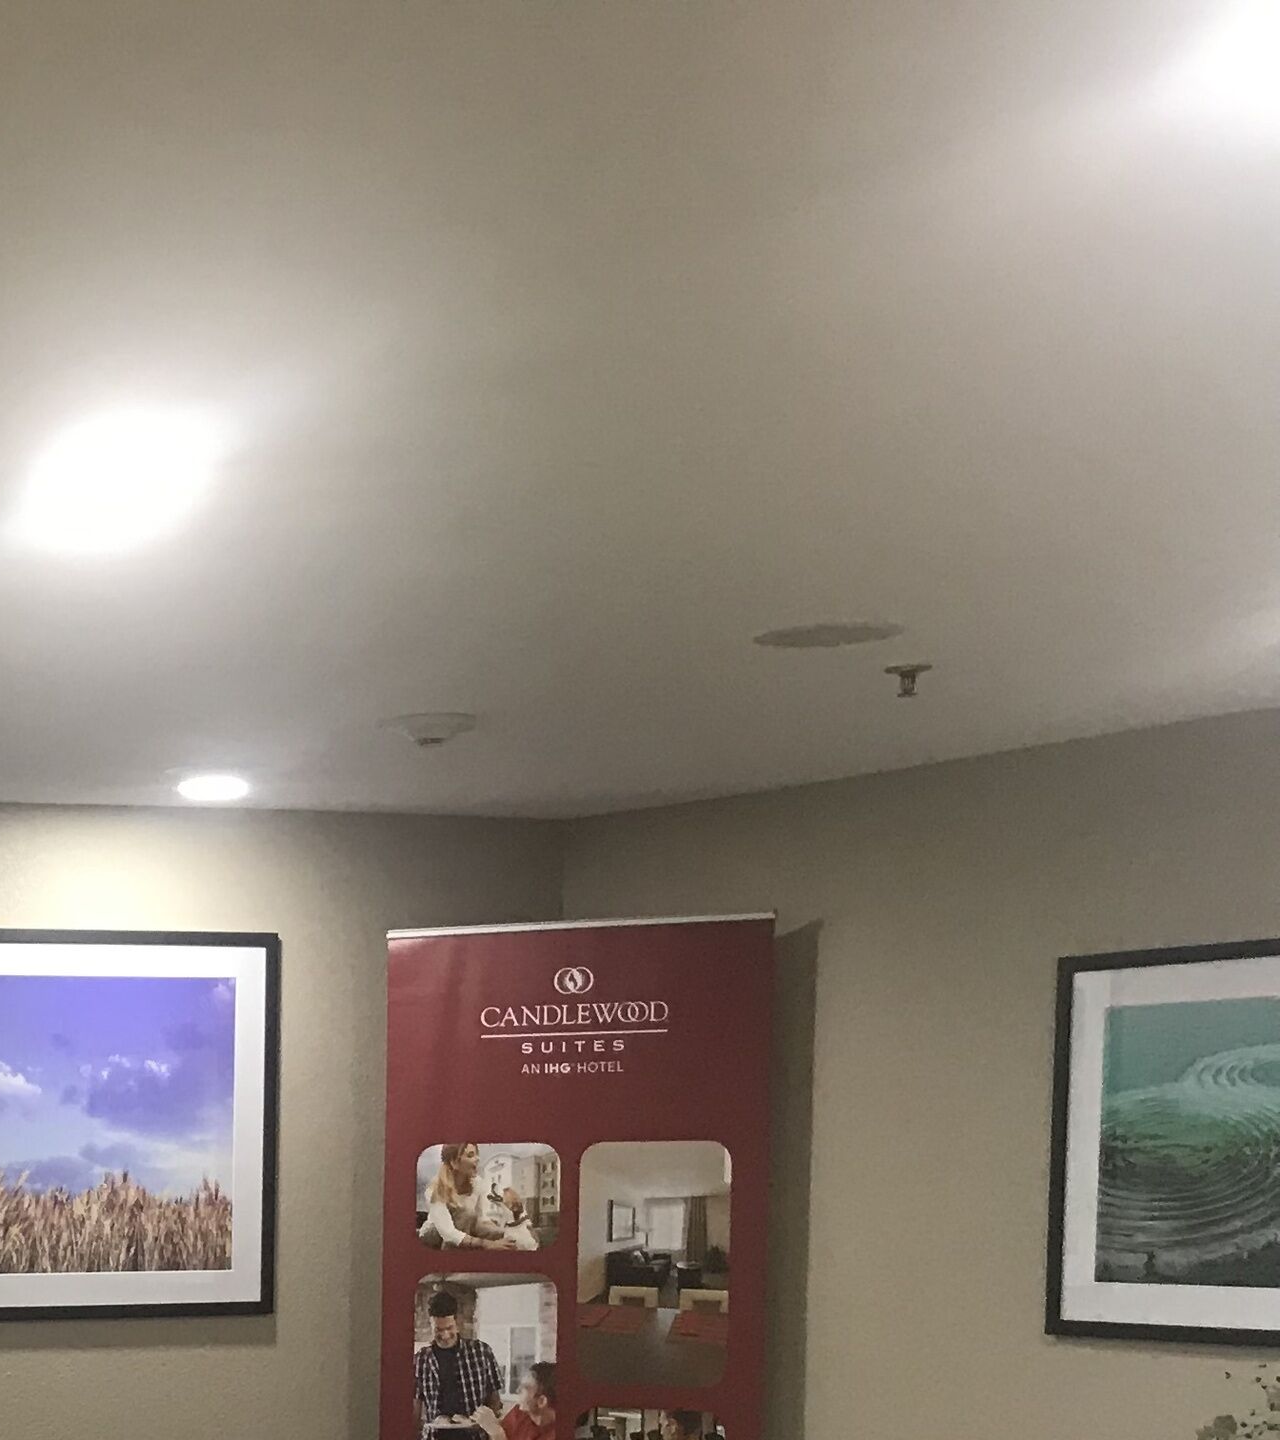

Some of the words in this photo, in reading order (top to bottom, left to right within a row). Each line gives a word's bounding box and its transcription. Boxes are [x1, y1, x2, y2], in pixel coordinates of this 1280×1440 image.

[480, 999, 669, 1028] CANDLEWOOD
[521, 1039, 625, 1054] SUITES
[521, 1063, 540, 1074] AN
[577, 1060, 624, 1073] HOTEL
